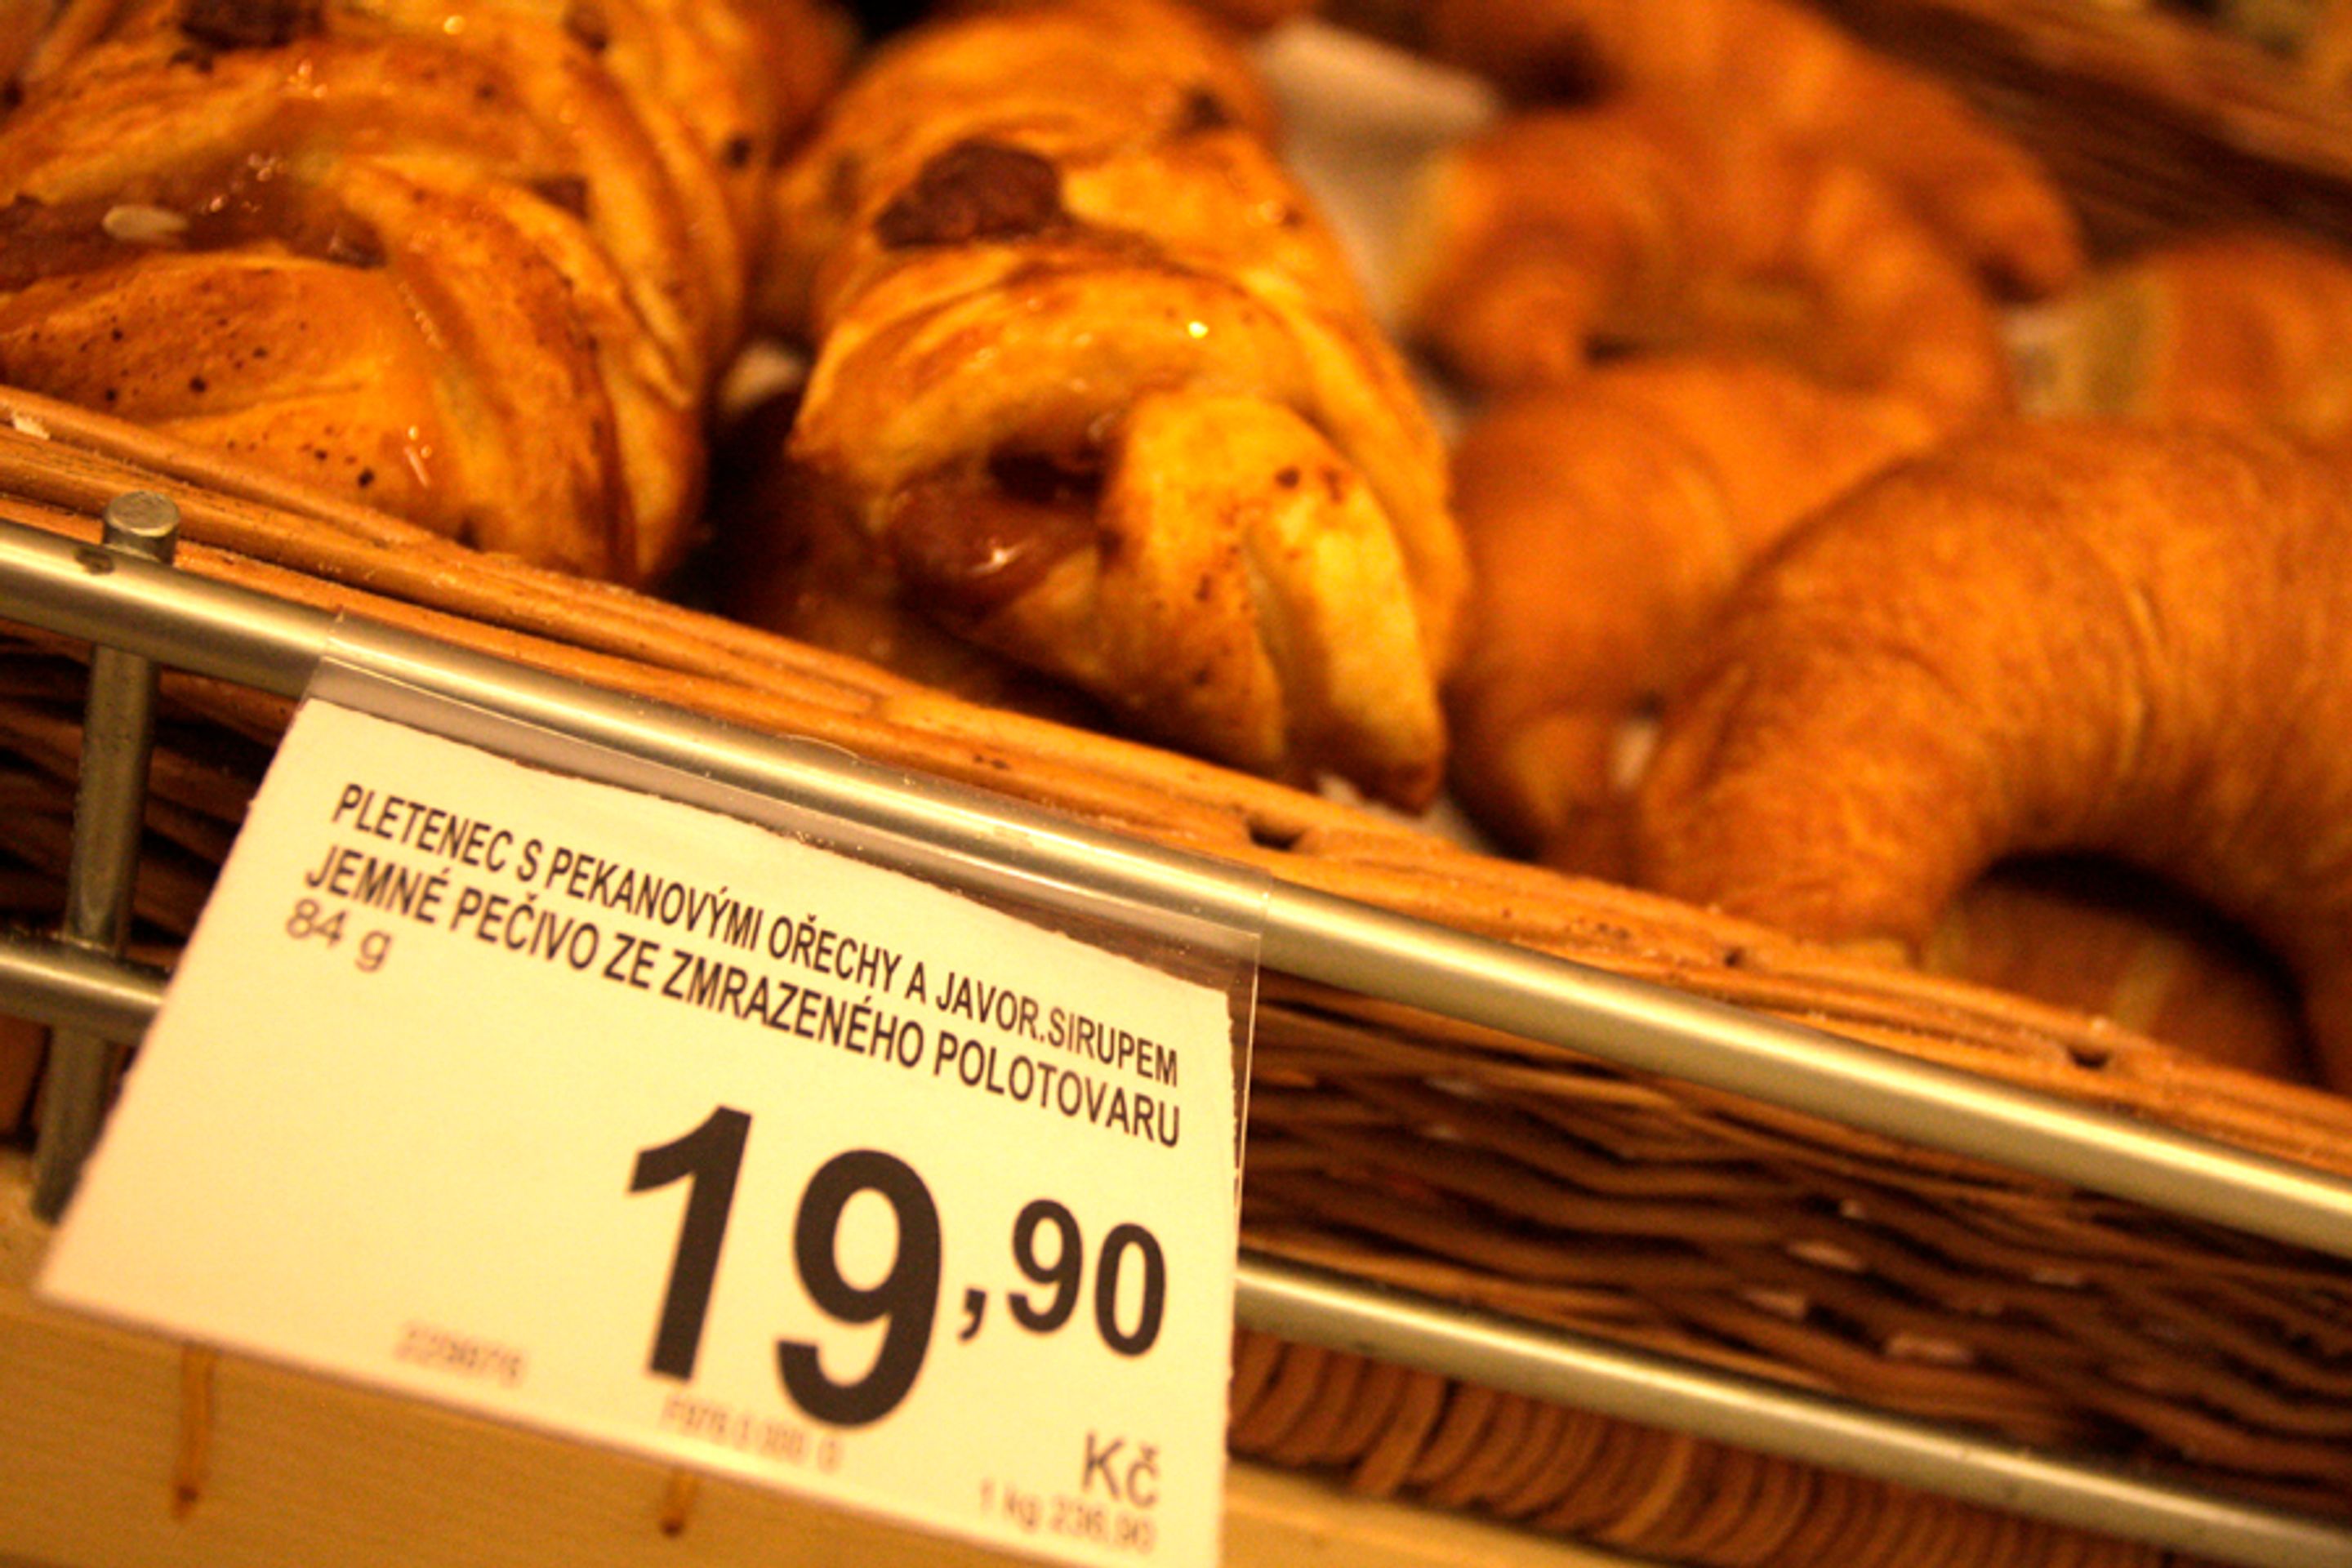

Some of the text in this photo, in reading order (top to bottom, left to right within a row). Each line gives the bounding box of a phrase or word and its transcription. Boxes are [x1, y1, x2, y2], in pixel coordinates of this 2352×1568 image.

[286, 898, 394, 973] 84 g
[333, 784, 514, 873] PLETENEC
[518, 839, 544, 883] S
[546, 847, 764, 952] PEKANOVÝMI
[768, 915, 902, 994] OŘECHY
[905, 962, 927, 1004] A
[306, 846, 1180, 1148] JEMNÉ PEČIVO ZE ZMRAZENÉHO POLOTOVARU
[1083, 1432, 1160, 1510] Kč
